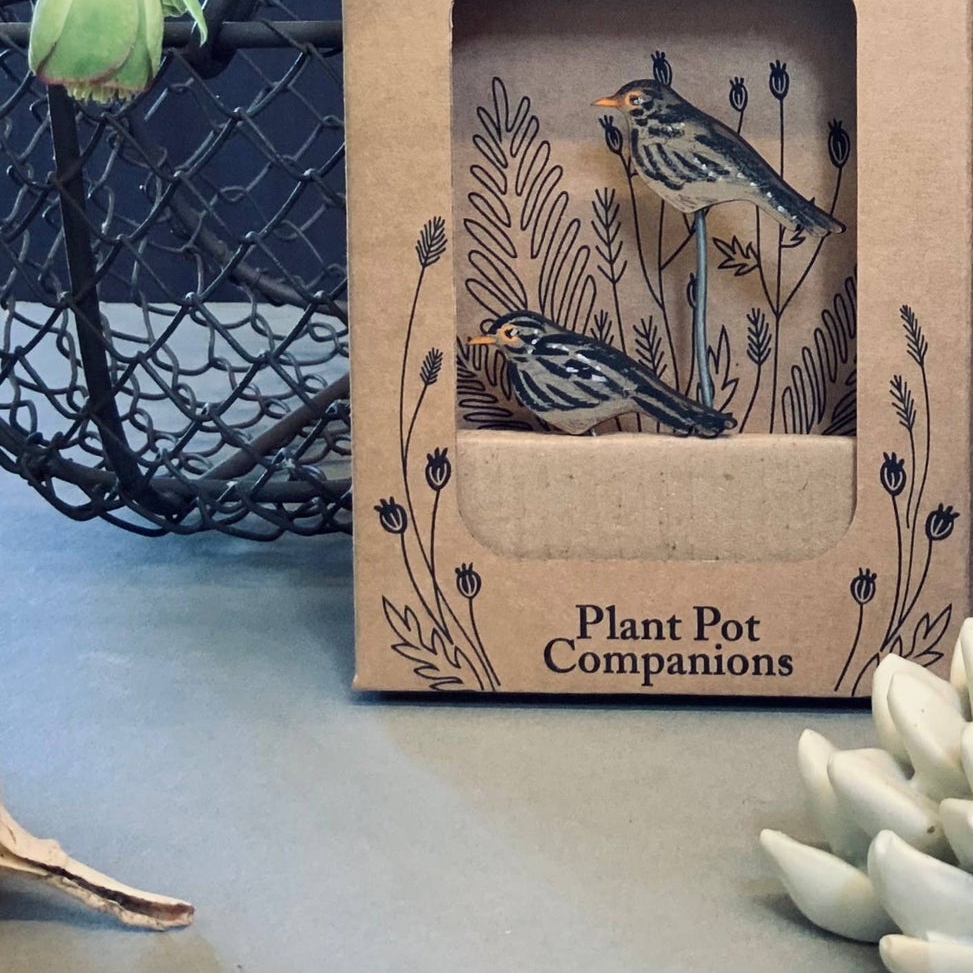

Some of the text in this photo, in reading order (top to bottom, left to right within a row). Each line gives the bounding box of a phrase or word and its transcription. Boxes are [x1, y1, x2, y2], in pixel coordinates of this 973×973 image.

[575, 604, 761, 642] Plant Pot
[544, 637, 793, 688] Companions
